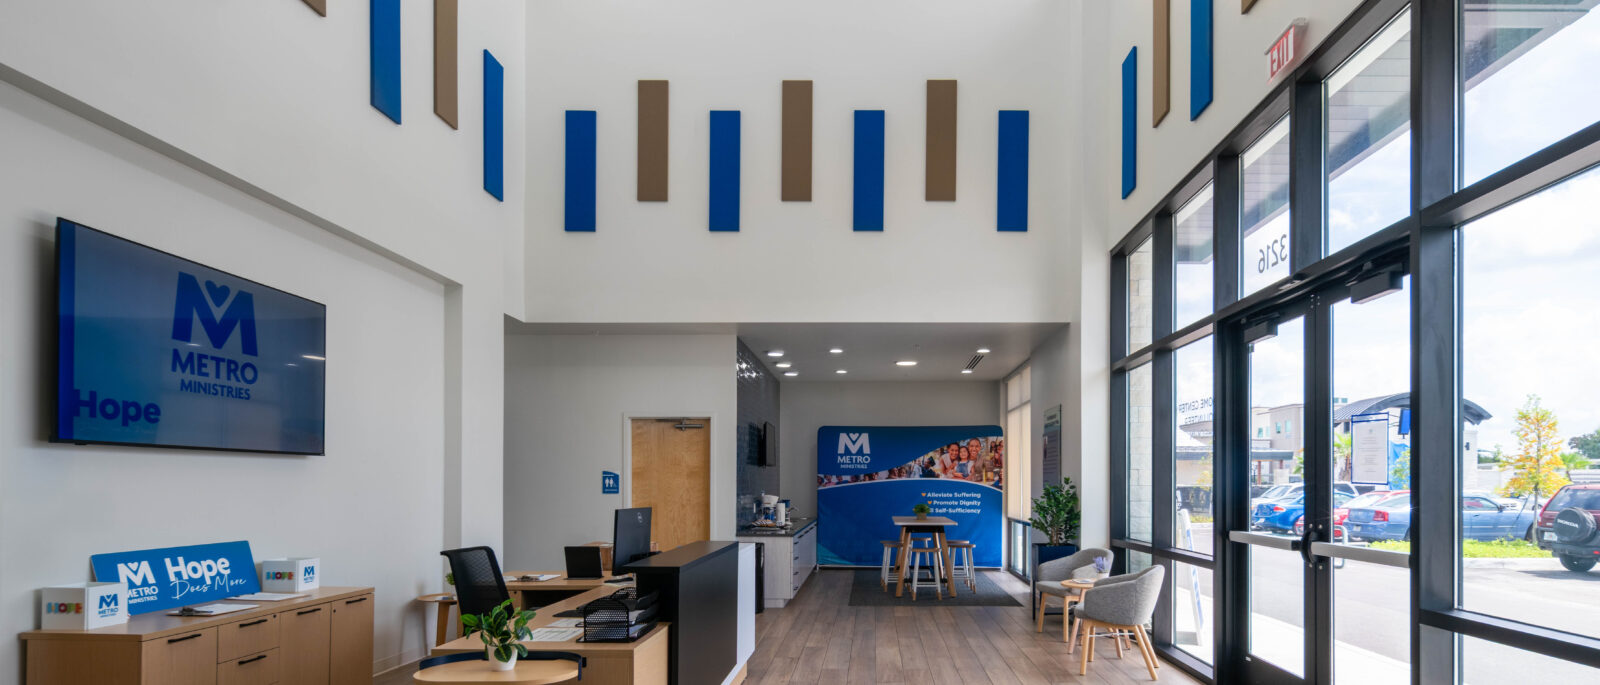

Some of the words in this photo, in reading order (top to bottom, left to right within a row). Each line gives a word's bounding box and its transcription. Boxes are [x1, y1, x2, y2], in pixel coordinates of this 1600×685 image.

[1270, 30, 1290, 78] EXIT
[171, 348, 258, 384] METRO
[180, 378, 251, 400] MINISTRIES
[72, 389, 161, 427] Hope
[837, 455, 870, 464] METRO
[1557, 518, 1579, 529] HONDA
[164, 556, 231, 585] Hope
[266, 571, 294, 580] HOPE
[170, 577, 210, 600] Does
[214, 573, 247, 593] More
[46, 602, 83, 614] HOPE
[98, 607, 119, 615] METRO
